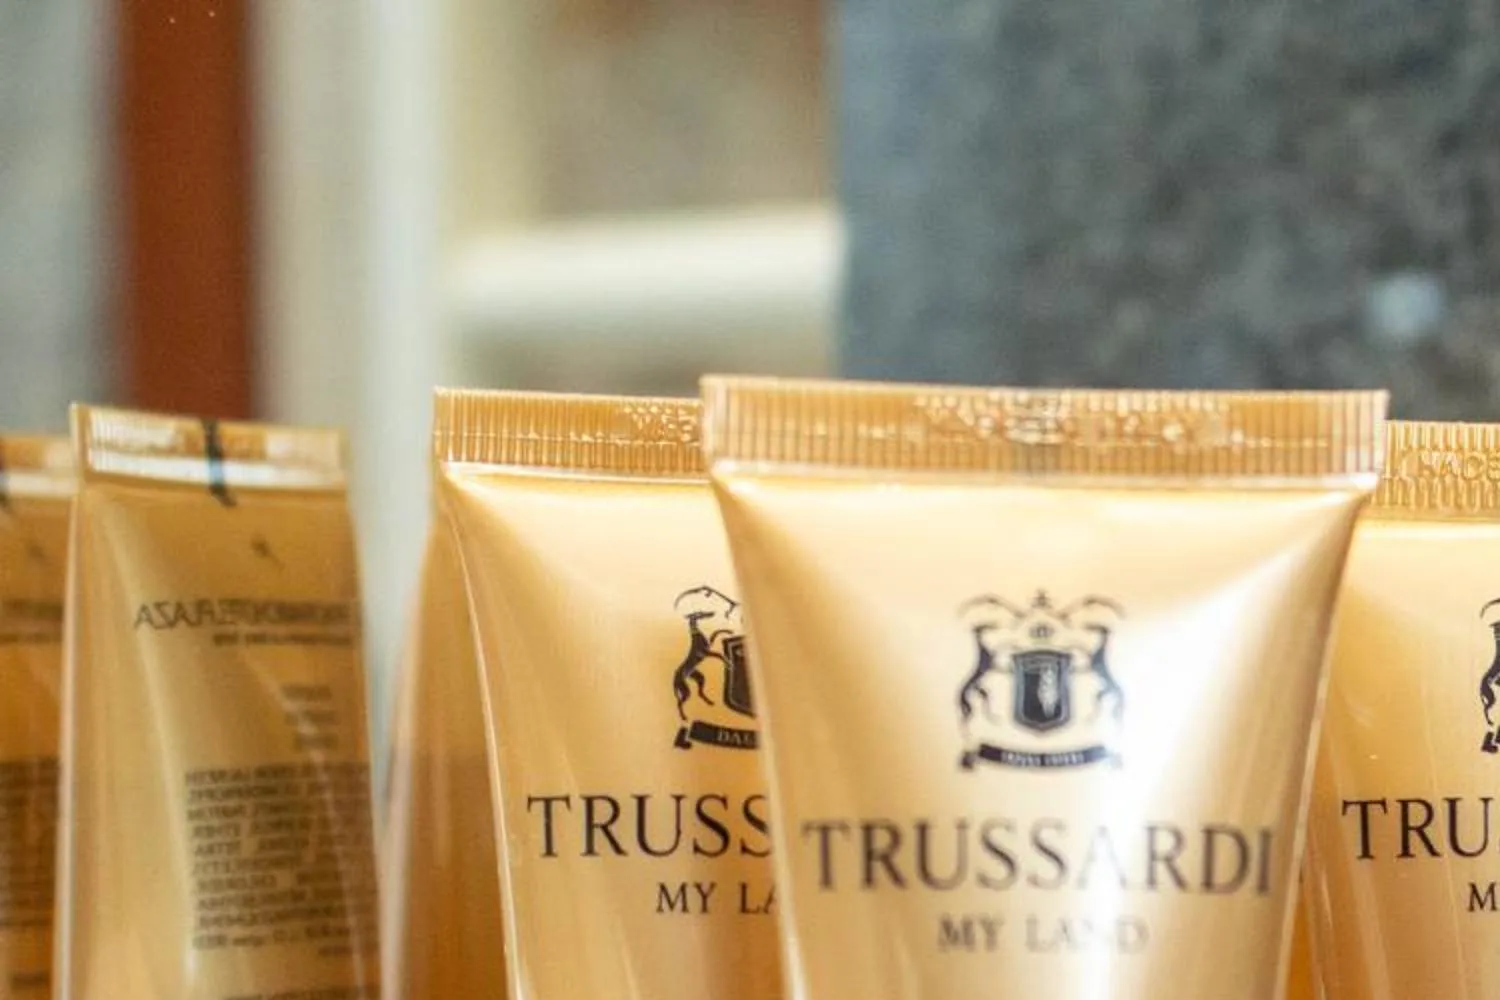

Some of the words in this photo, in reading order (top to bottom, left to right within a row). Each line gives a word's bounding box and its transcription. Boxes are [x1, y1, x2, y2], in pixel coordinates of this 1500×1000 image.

[527, 793, 772, 858] TRUSS
[802, 818, 1272, 896] TRUSSARDI
[655, 881, 718, 915] MY
[937, 914, 1005, 953] MY
[1024, 914, 1149, 955] LAND
